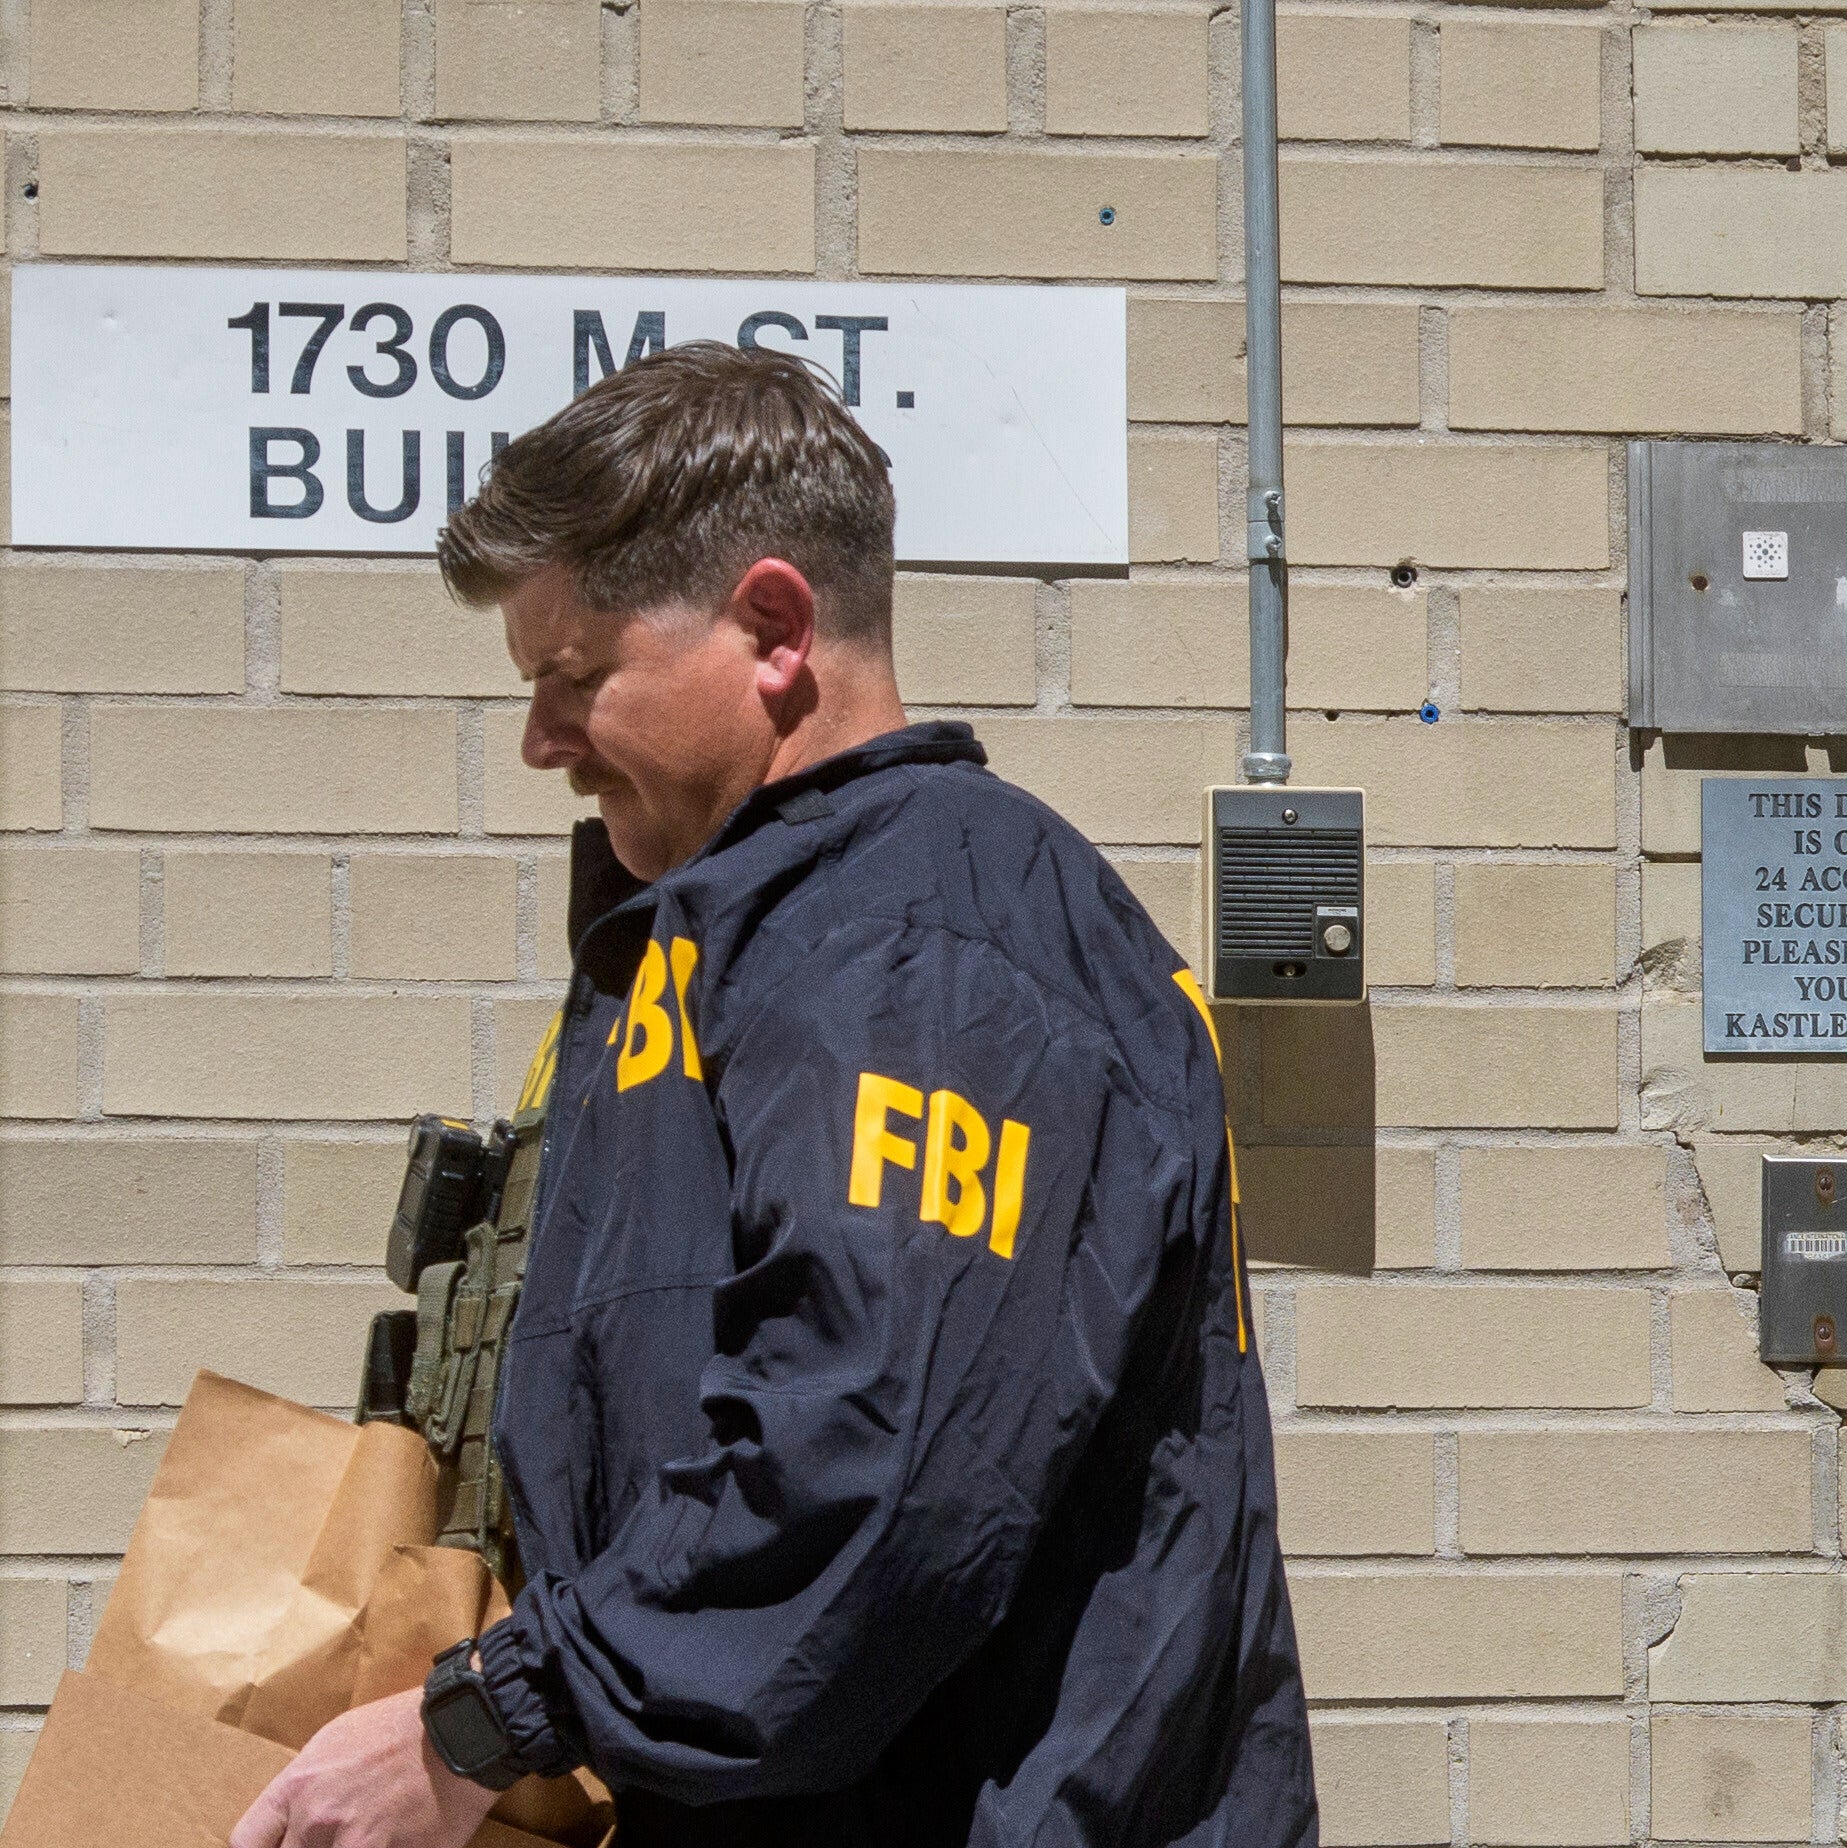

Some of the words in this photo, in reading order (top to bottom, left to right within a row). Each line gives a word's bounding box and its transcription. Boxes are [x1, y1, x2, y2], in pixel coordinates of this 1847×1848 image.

[228, 301, 506, 401] 1730
[1749, 793, 1822, 819] THIS
[1793, 830, 1822, 855] IS
[1755, 867, 1788, 892] 24
[606, 936, 704, 1093] BI
[849, 1073, 1030, 1259] FBI
